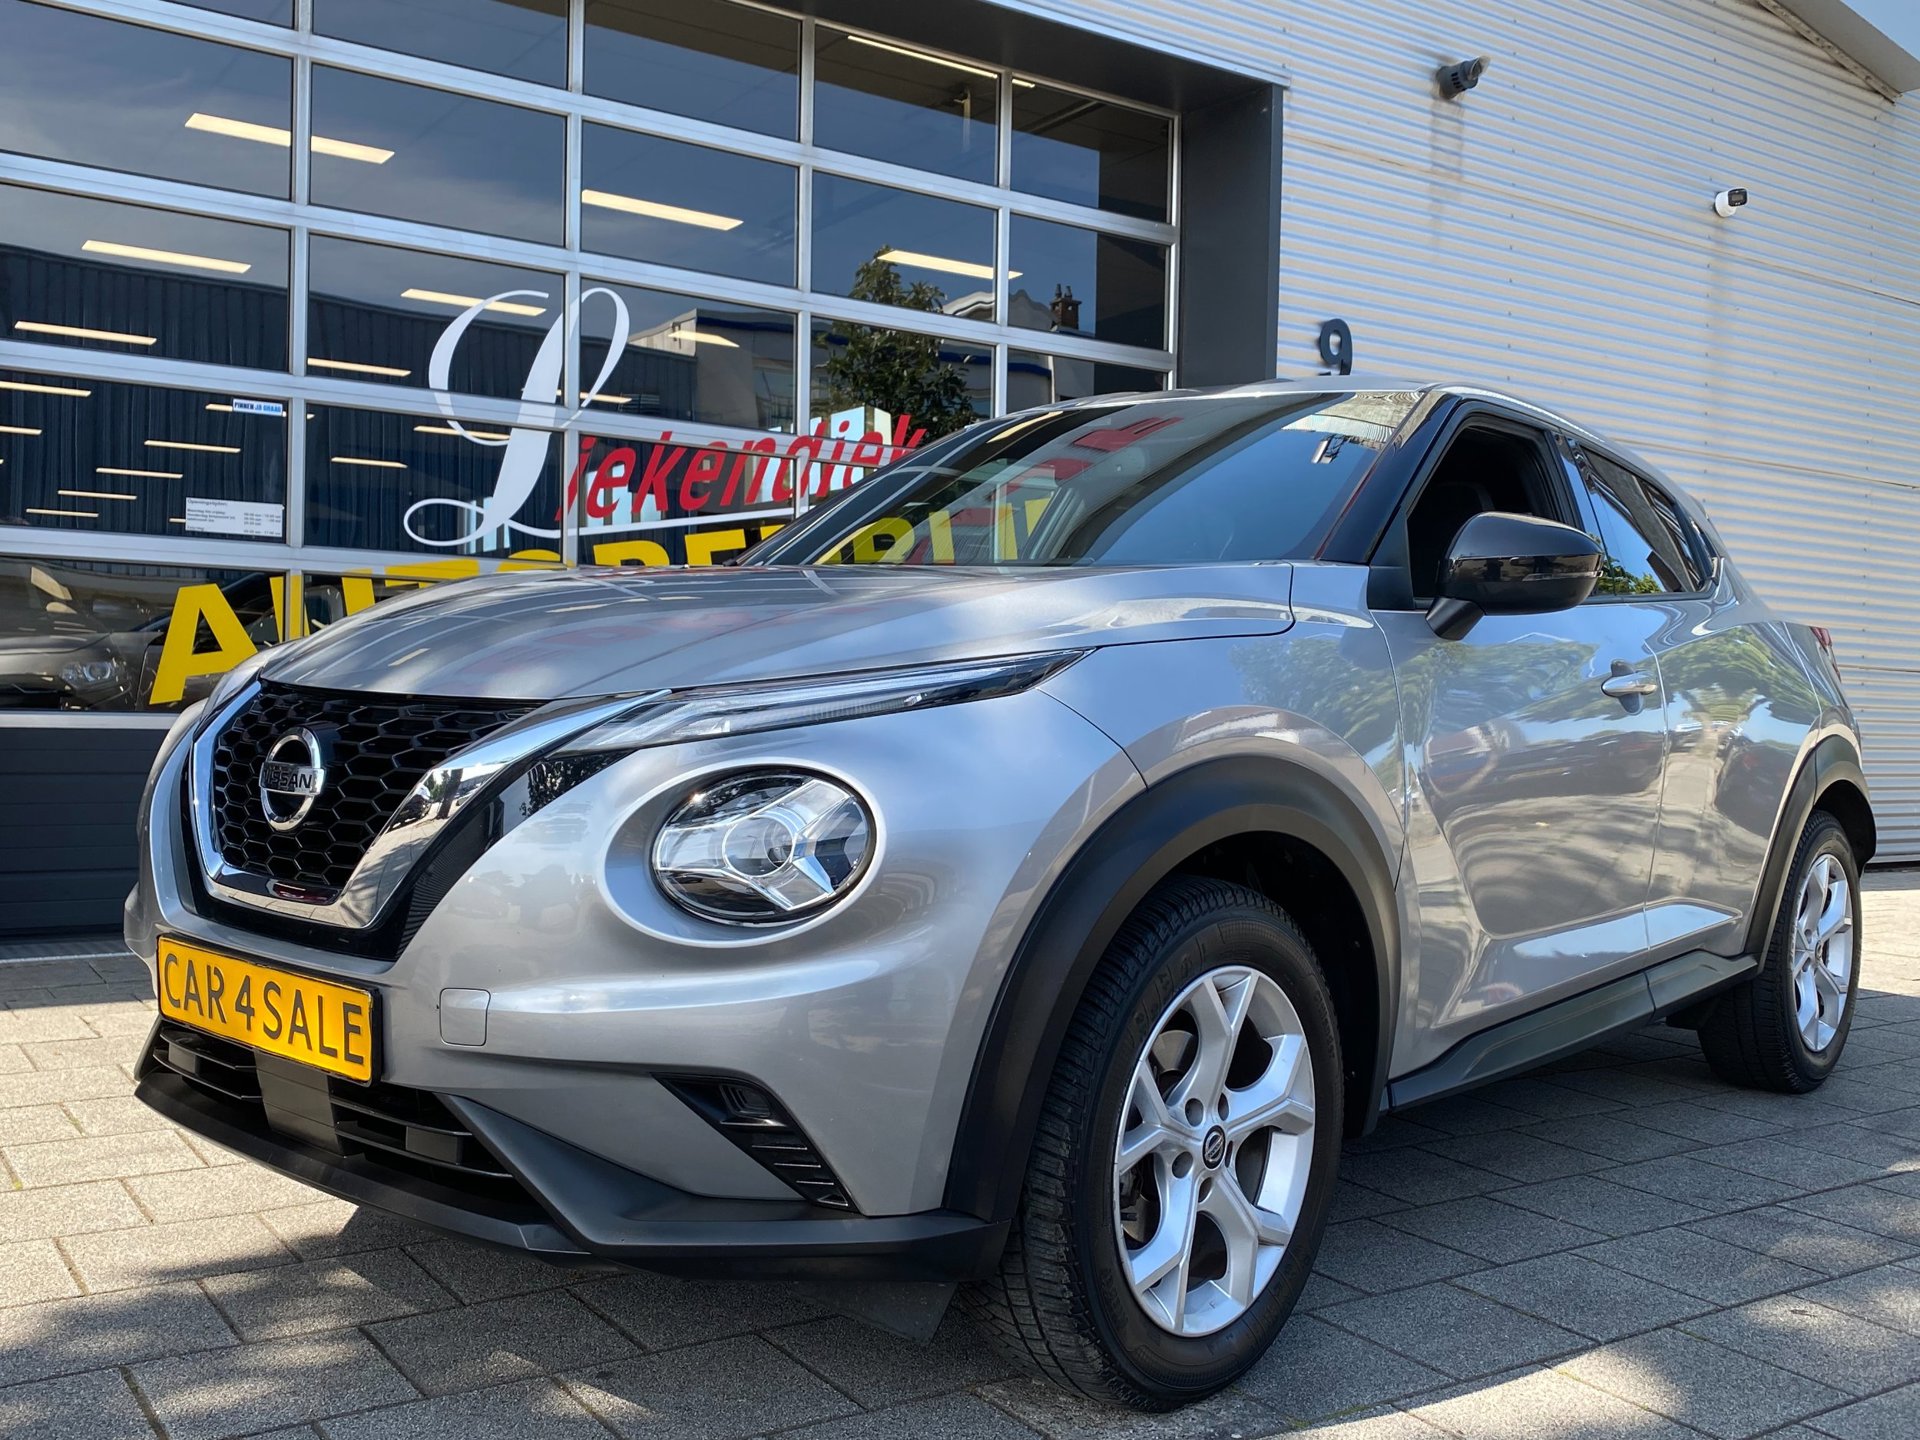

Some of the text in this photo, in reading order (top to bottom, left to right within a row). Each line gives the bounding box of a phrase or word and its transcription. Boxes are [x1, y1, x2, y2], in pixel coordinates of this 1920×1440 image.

[1318, 318, 1353, 375] 9
[264, 766, 312, 789] NISSAN
[164, 953, 365, 1065] CAR4SALE
